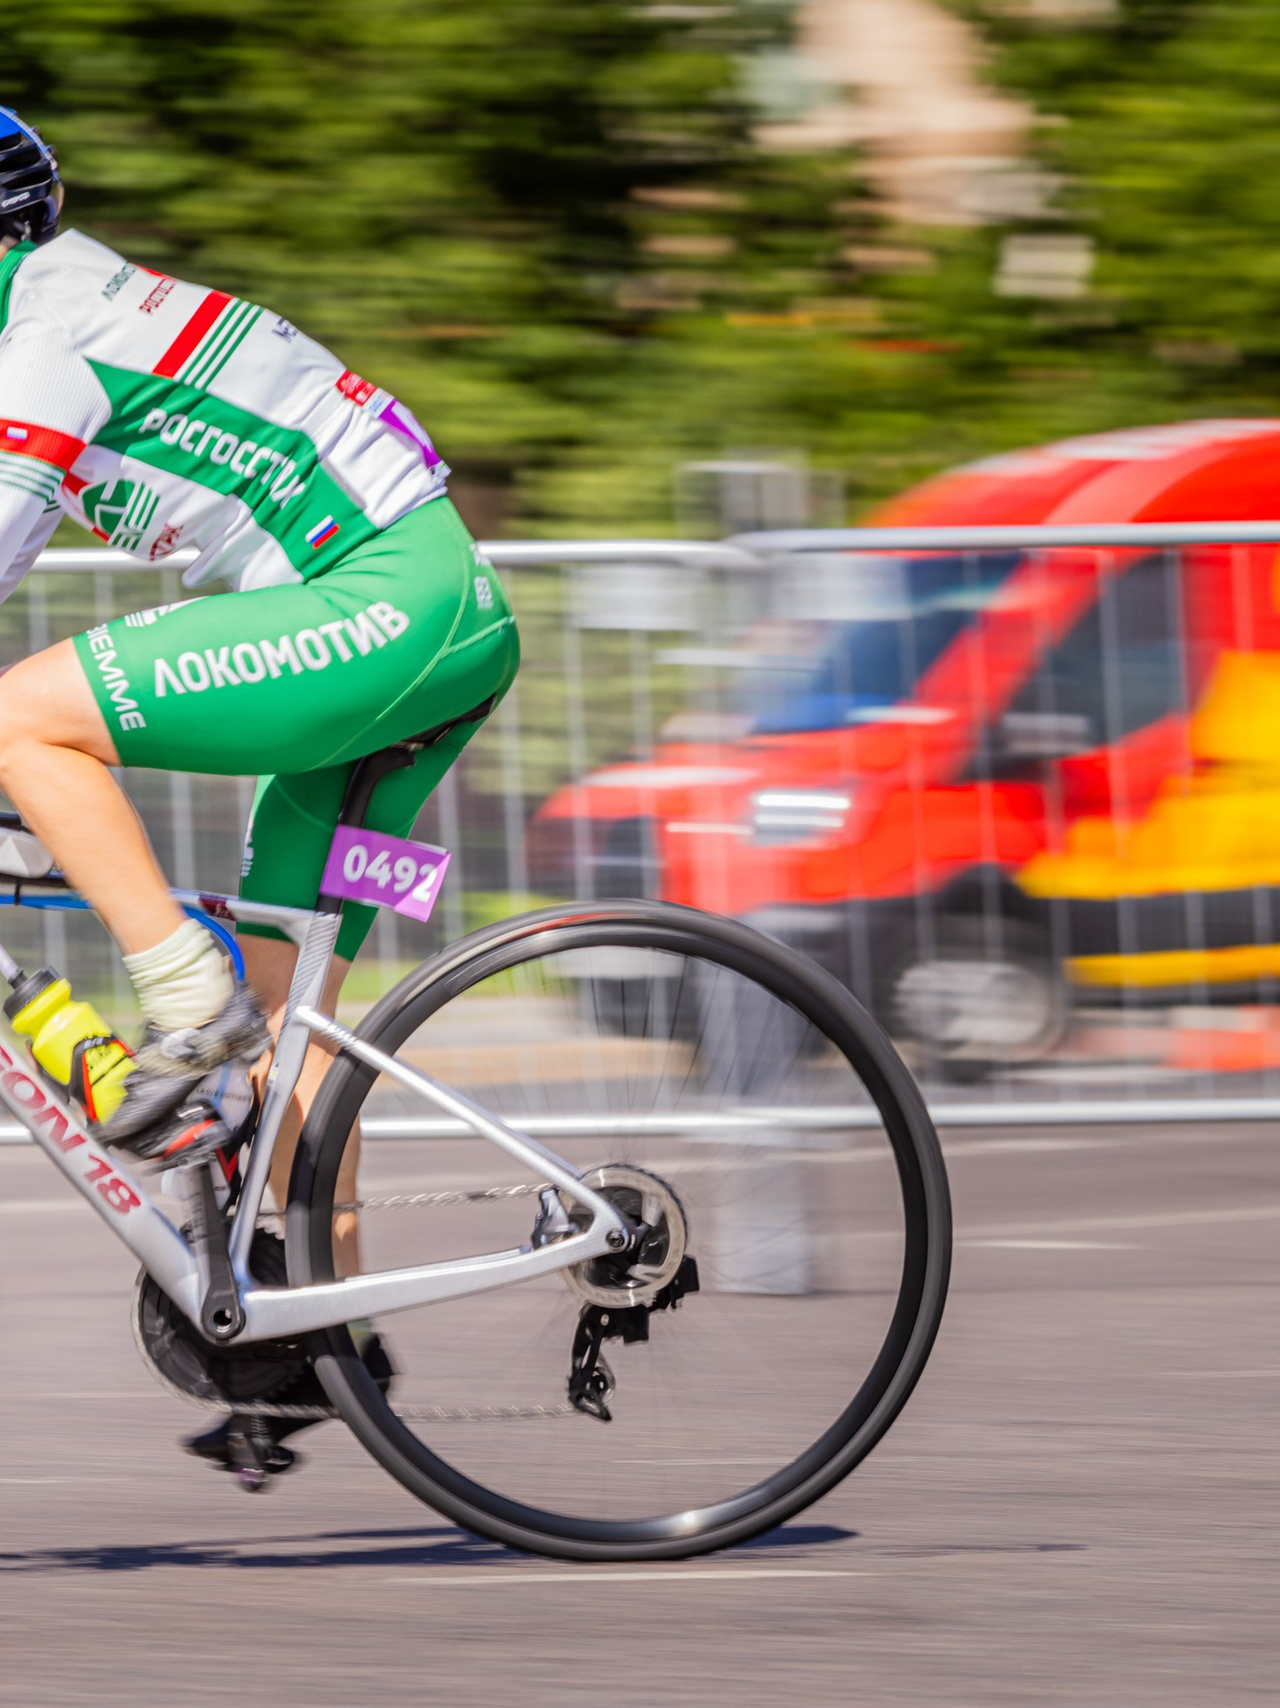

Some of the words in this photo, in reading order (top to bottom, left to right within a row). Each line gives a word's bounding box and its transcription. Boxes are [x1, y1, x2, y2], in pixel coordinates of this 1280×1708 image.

[154, 601, 411, 698] ЛОКОМОТИВ
[343, 844, 438, 903] 0492
[83, 1153, 142, 1215] 18
